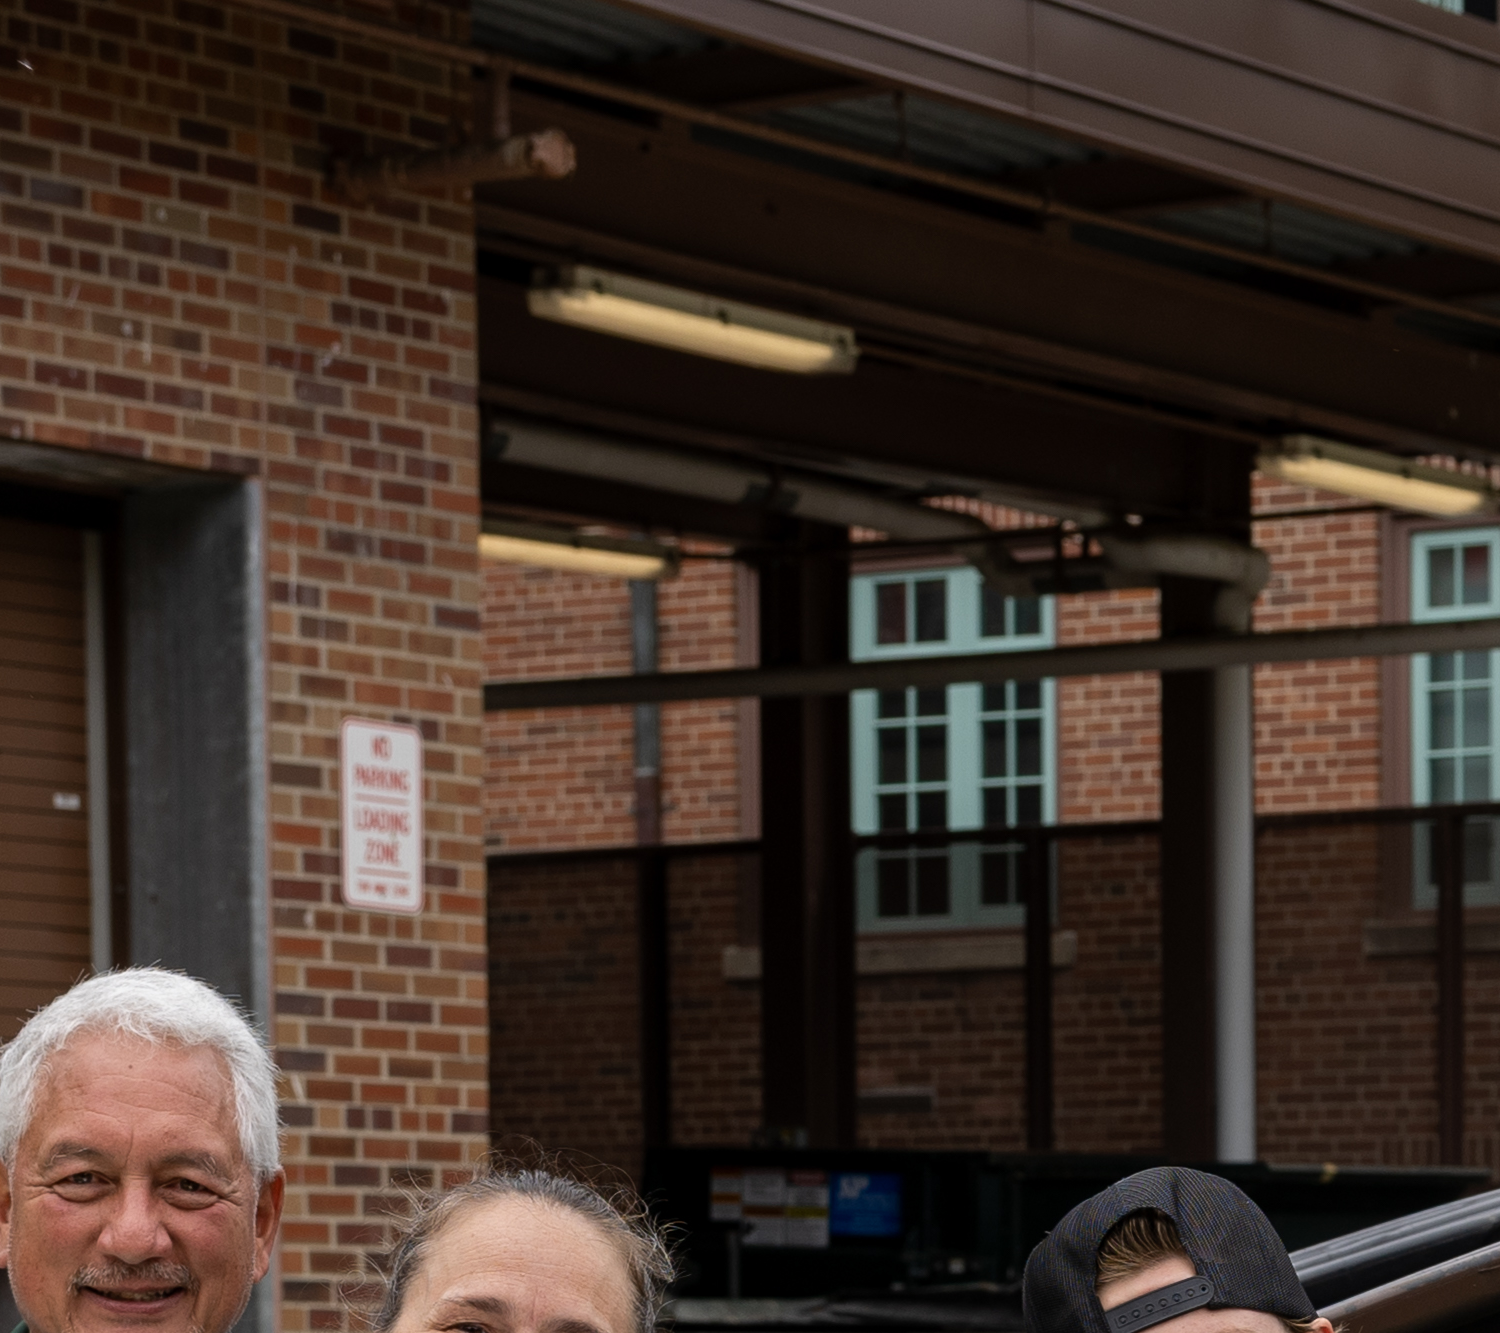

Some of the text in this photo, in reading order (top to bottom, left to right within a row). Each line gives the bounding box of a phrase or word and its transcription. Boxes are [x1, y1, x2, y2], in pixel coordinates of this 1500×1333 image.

[371, 735, 392, 760] NO
[355, 764, 410, 794] PARKING
[355, 808, 411, 837] LOADING
[365, 838, 400, 865] ZONE
